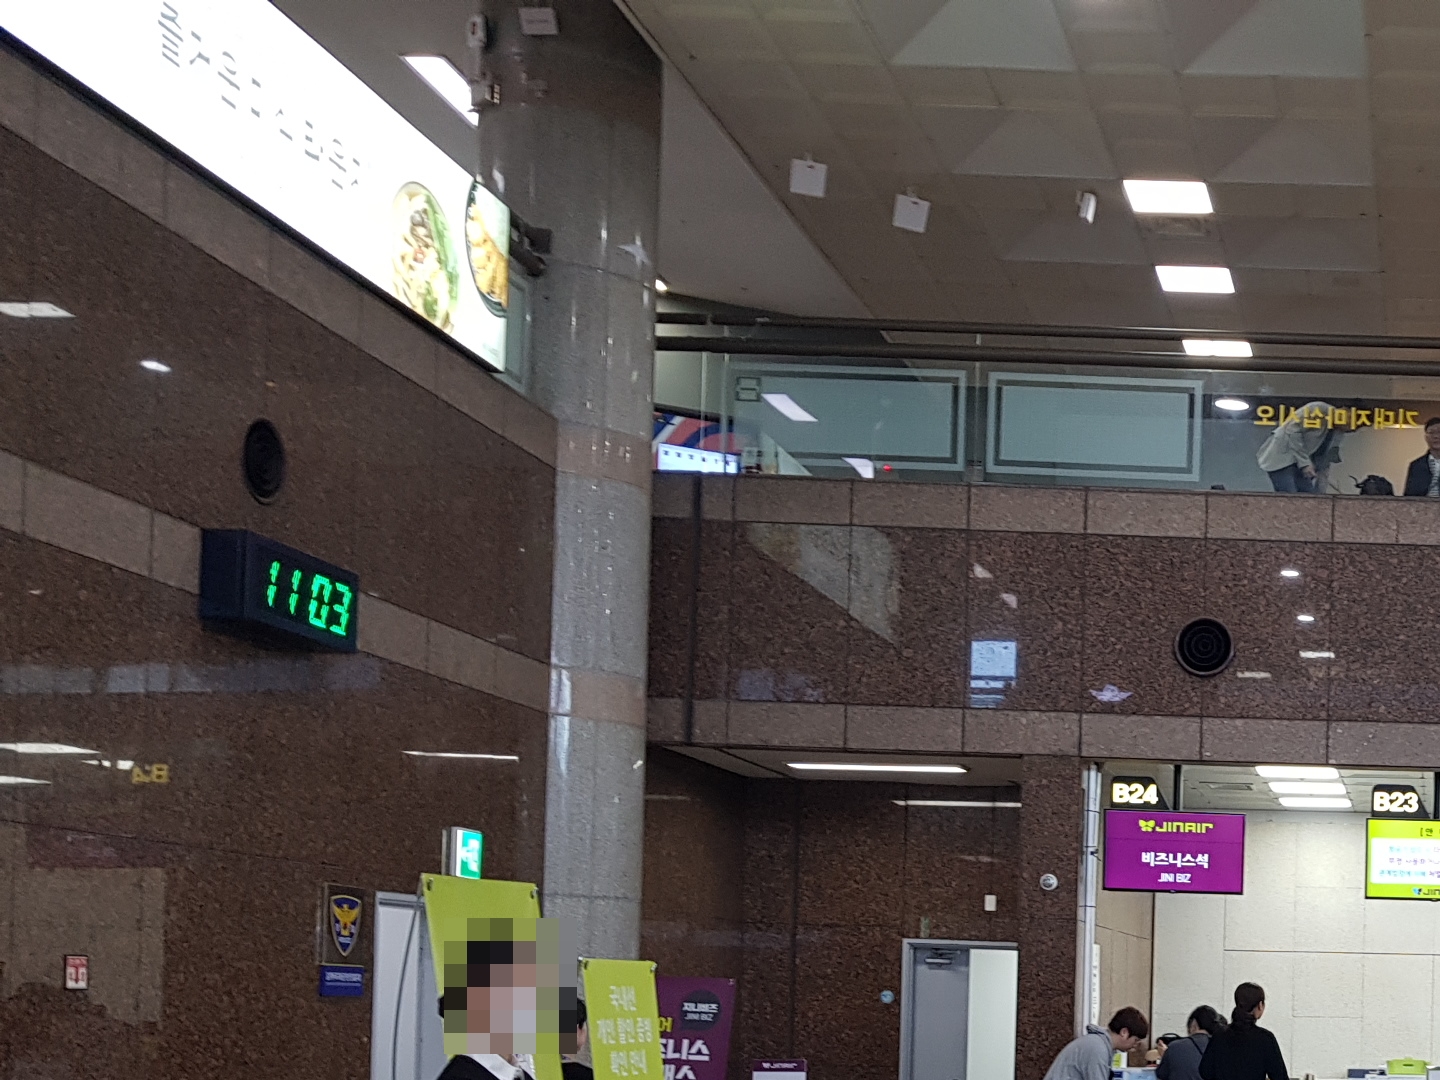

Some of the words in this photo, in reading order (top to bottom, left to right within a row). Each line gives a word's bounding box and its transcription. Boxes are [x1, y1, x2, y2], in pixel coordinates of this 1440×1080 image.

[1112, 783, 1159, 804] B24
[1373, 791, 1419, 813] B23
[1141, 851, 1209, 869] 비즈니스석
